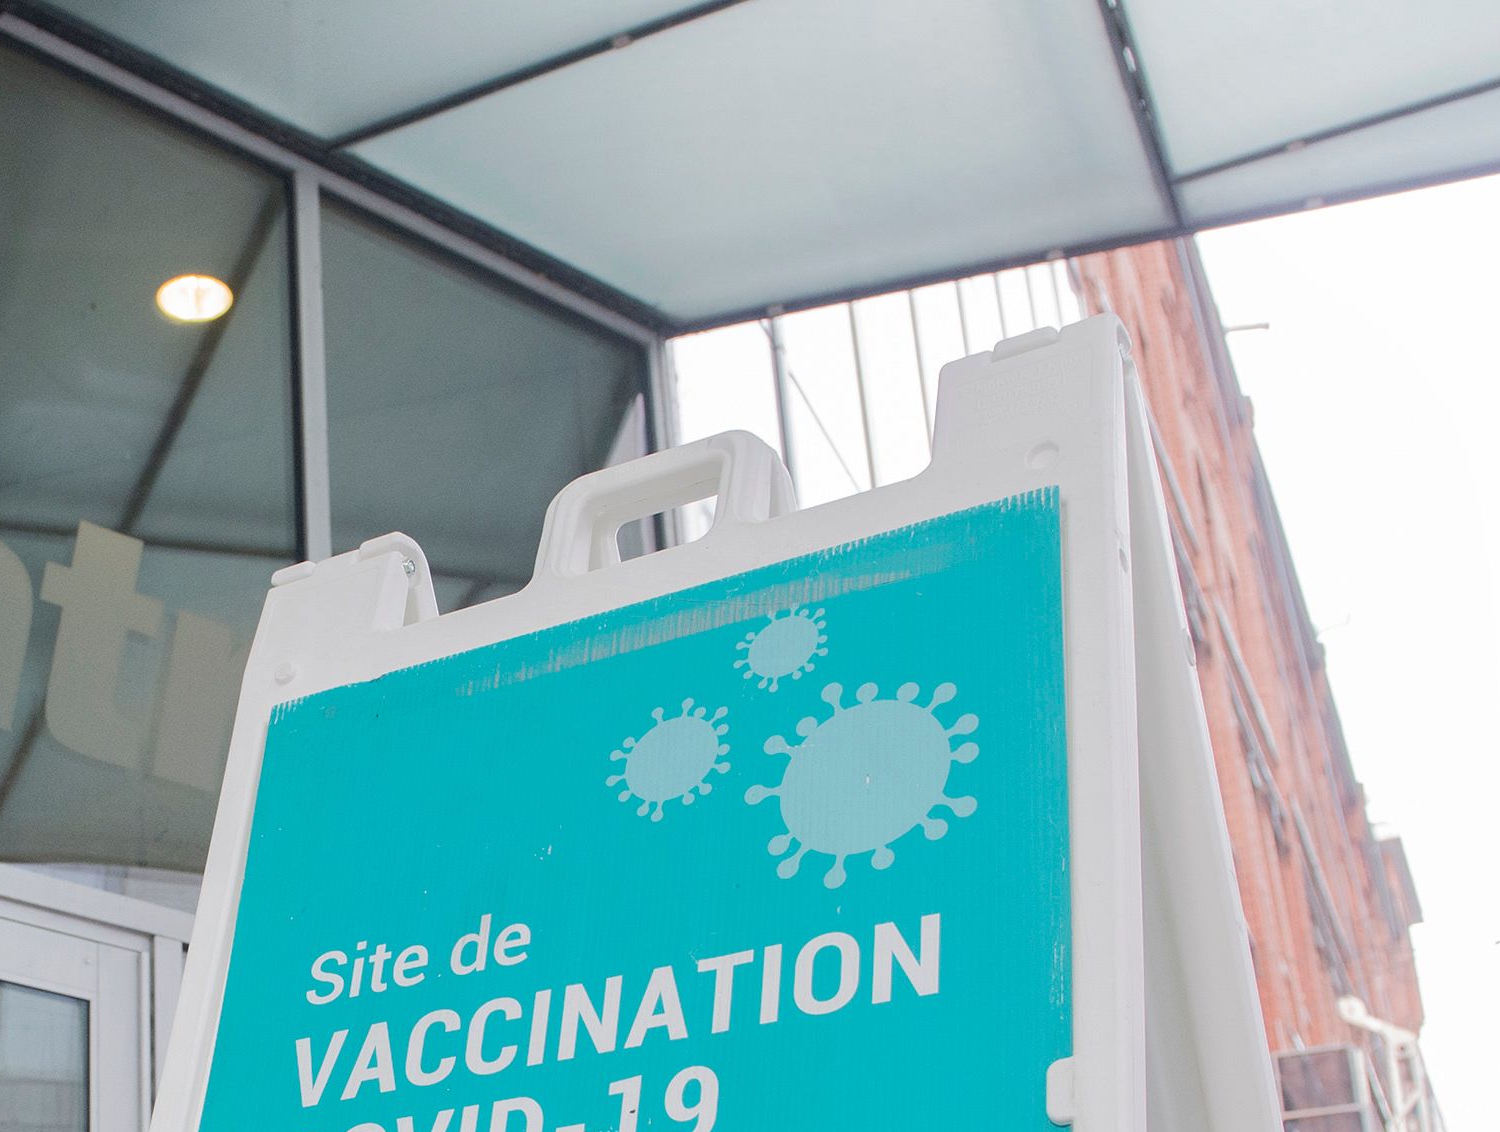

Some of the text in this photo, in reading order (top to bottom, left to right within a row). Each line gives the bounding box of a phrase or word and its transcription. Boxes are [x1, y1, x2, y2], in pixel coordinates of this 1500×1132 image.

[294, 912, 941, 1109] VACCINATION
[305, 913, 532, 1006] Site de
